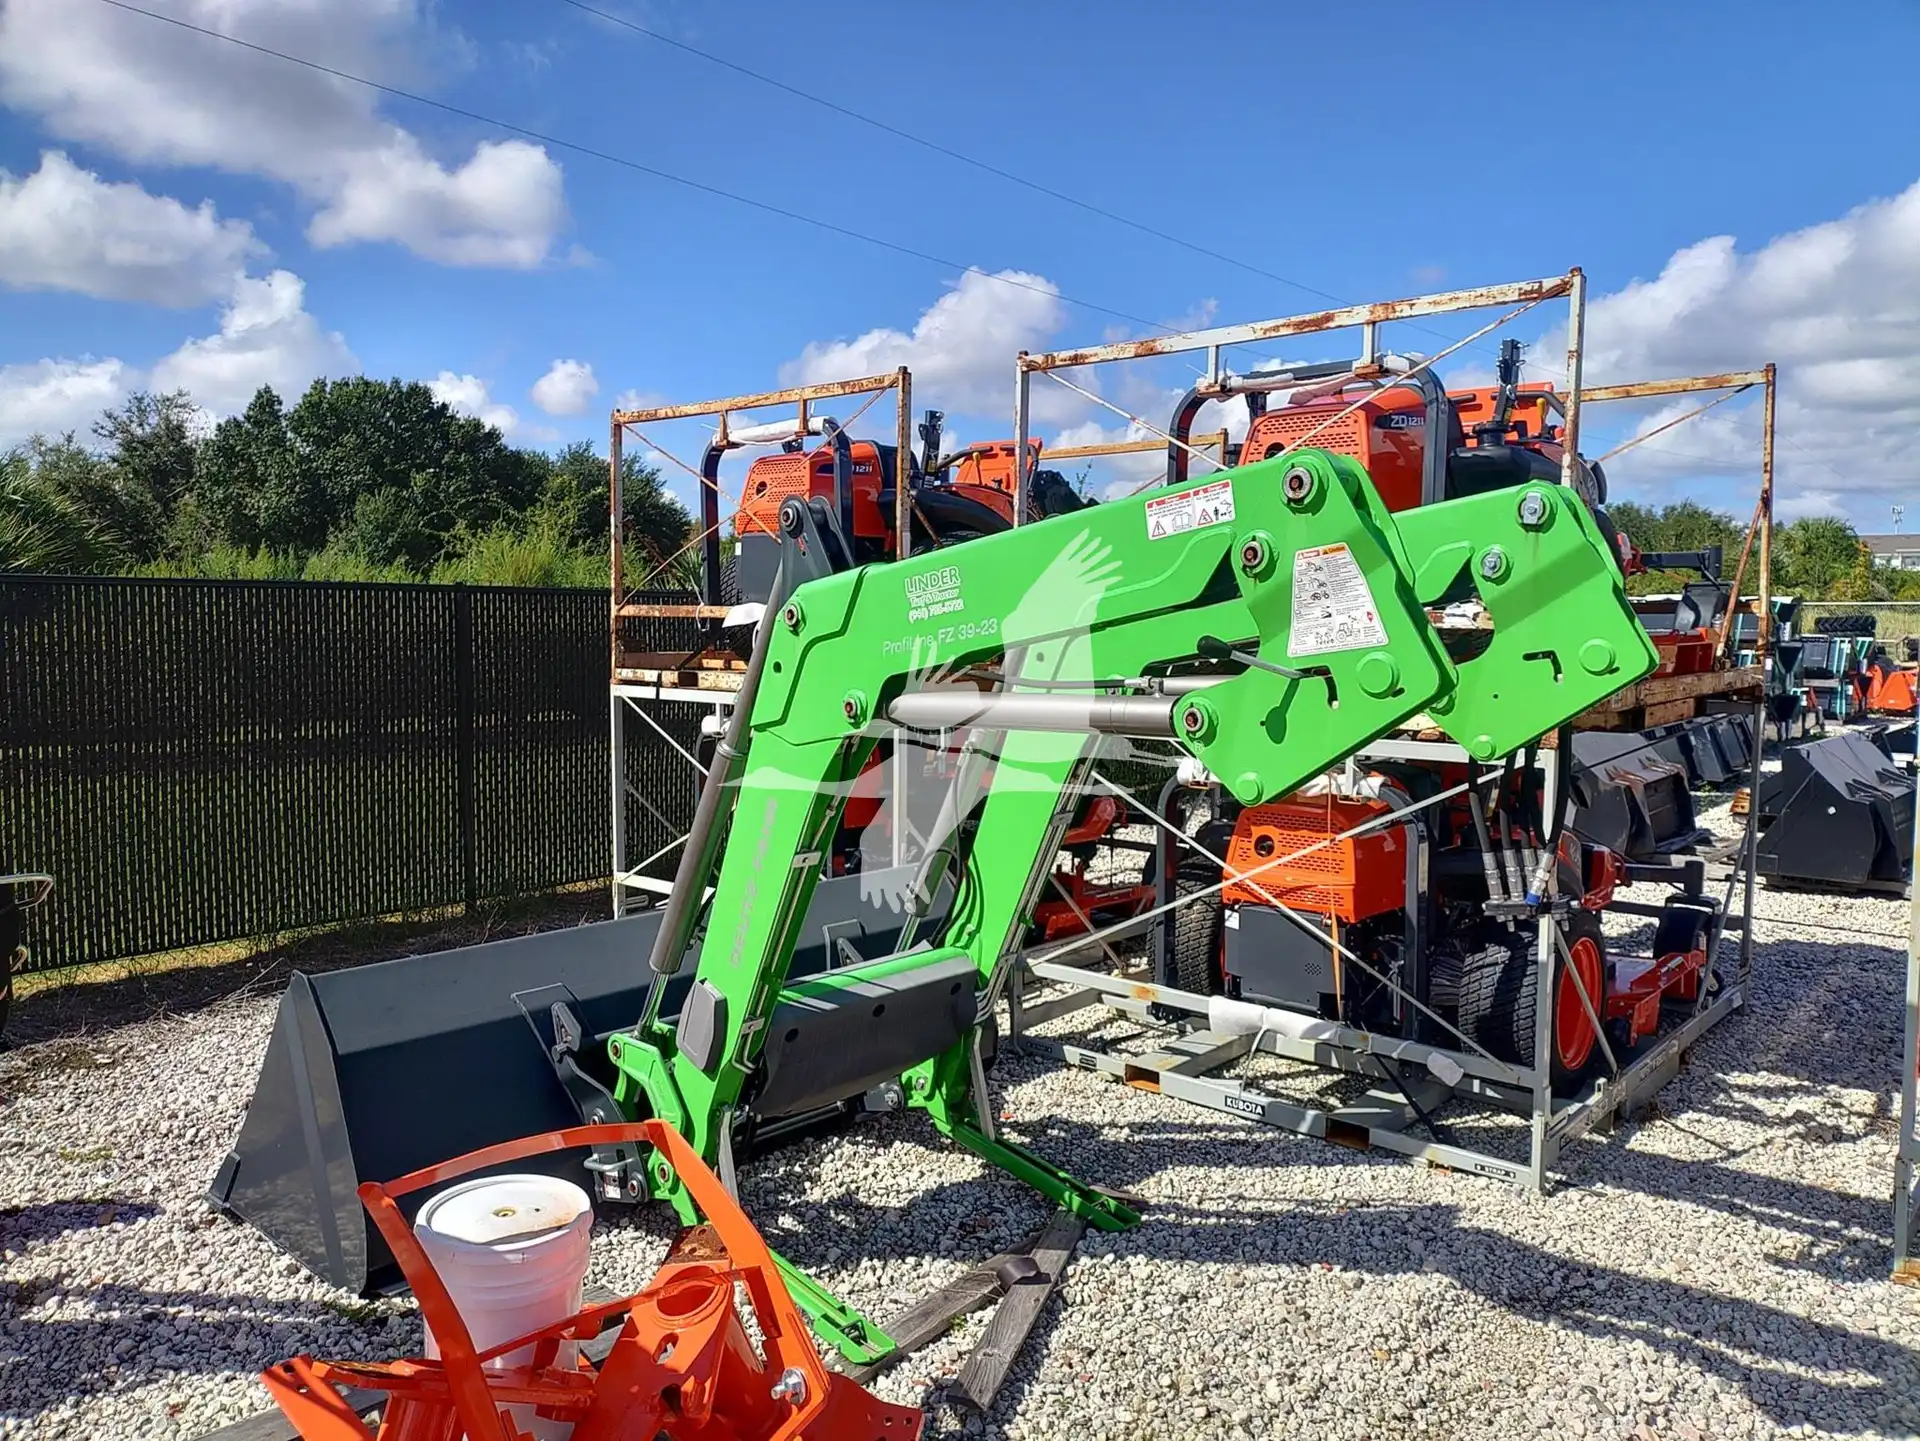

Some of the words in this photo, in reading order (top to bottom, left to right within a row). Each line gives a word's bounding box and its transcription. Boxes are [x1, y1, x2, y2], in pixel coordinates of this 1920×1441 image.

[905, 567, 961, 595] LINDER
[938, 626, 955, 643] FZ
[958, 618, 998, 640] 39-23
[1226, 1097, 1264, 1115] KUBOTA
